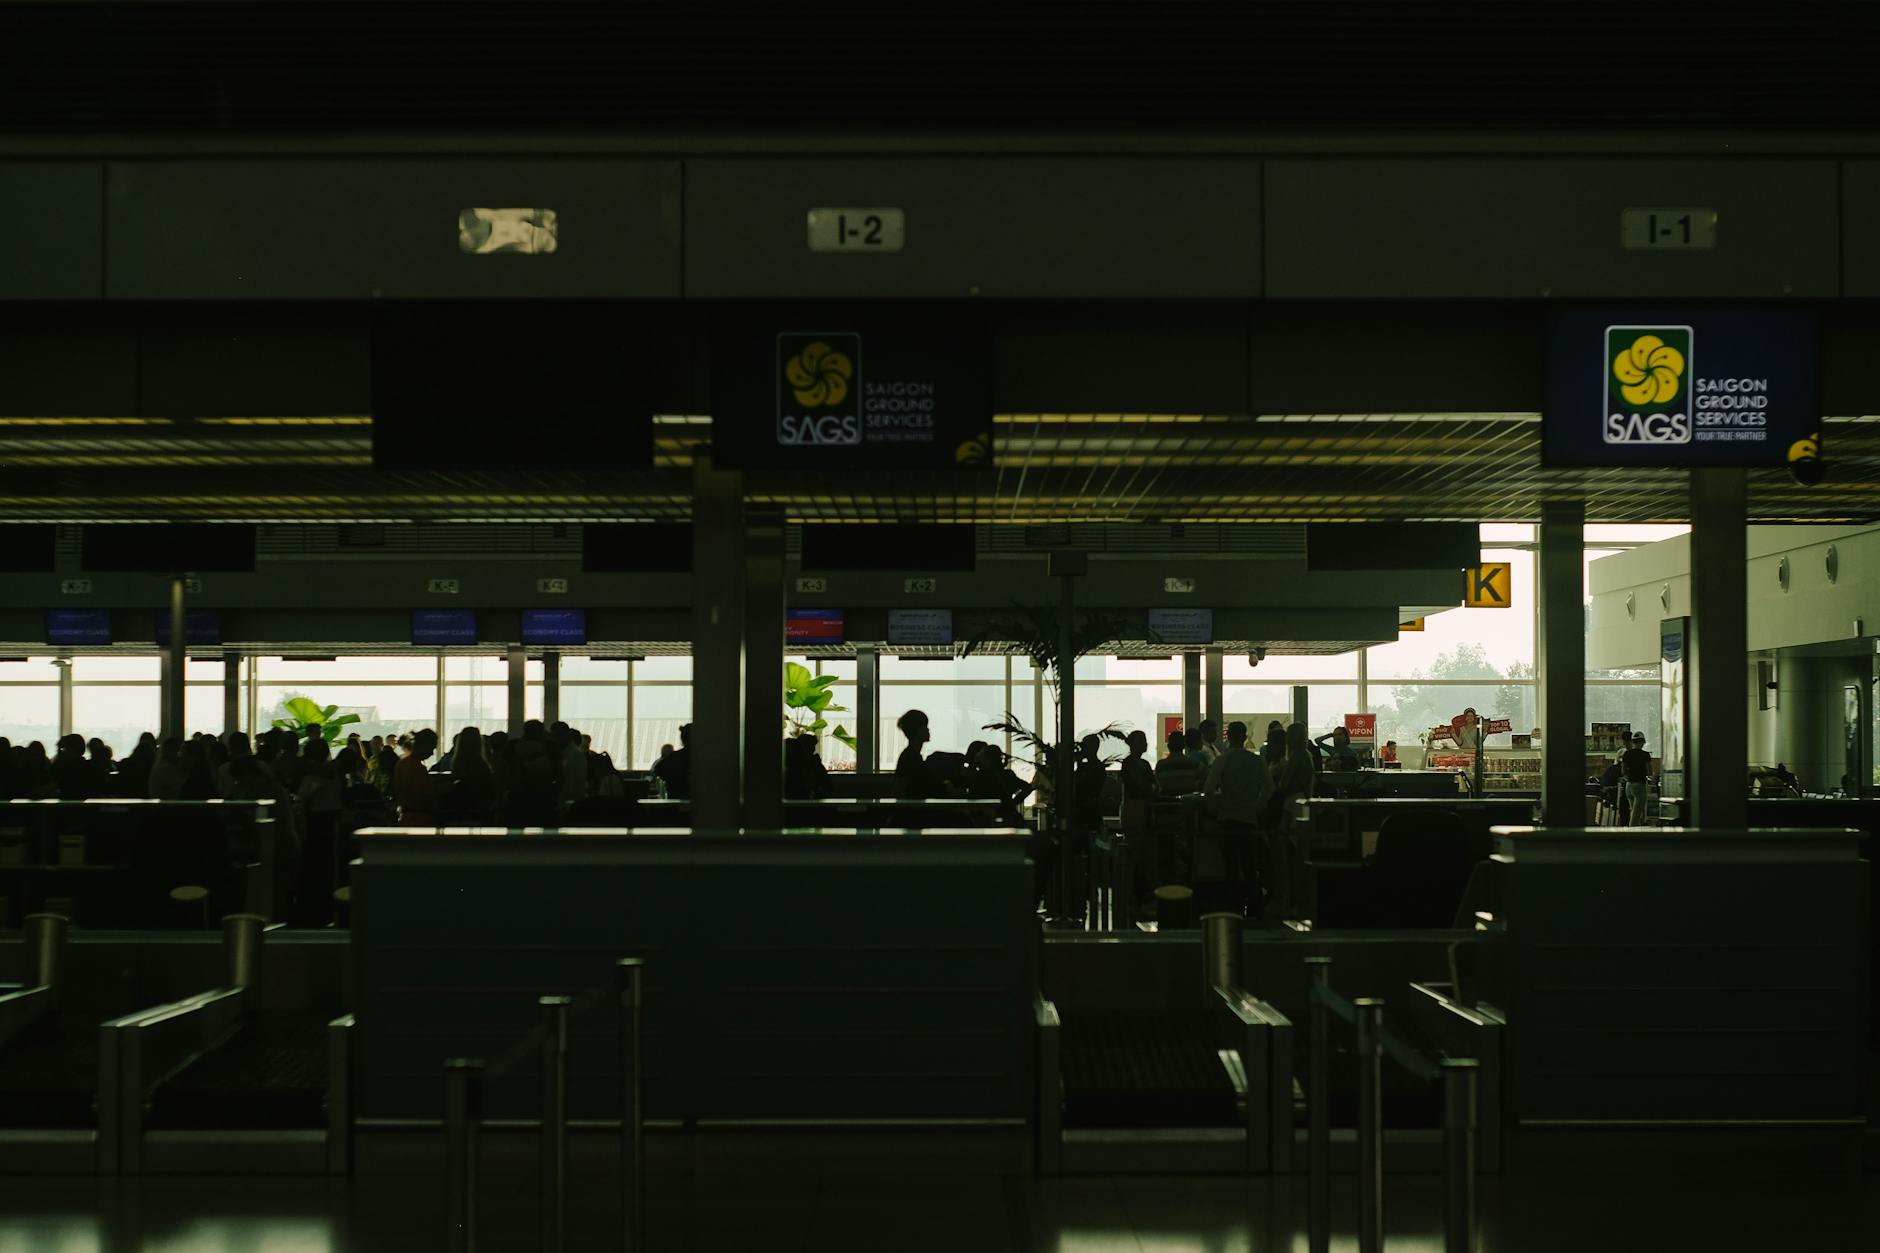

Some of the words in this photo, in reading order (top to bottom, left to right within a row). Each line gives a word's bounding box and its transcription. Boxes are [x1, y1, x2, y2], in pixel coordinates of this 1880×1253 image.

[838, 215, 883, 245] I-2
[1648, 213, 1691, 244] I-1
[865, 382, 934, 396] SAIGON
[1695, 378, 1768, 392] SAIGON
[865, 398, 935, 411] GROUND
[1694, 395, 1769, 409] GROUND
[865, 414, 934, 428] SERVICES
[1695, 411, 1767, 425] SERVICES
[781, 415, 858, 444] SAGS
[1608, 413, 1689, 442] SAGS
[802, 581, 823, 591] K-3
[911, 581, 932, 592] K-2
[1474, 567, 1504, 602] K
[1348, 728, 1373, 736] VIFON
